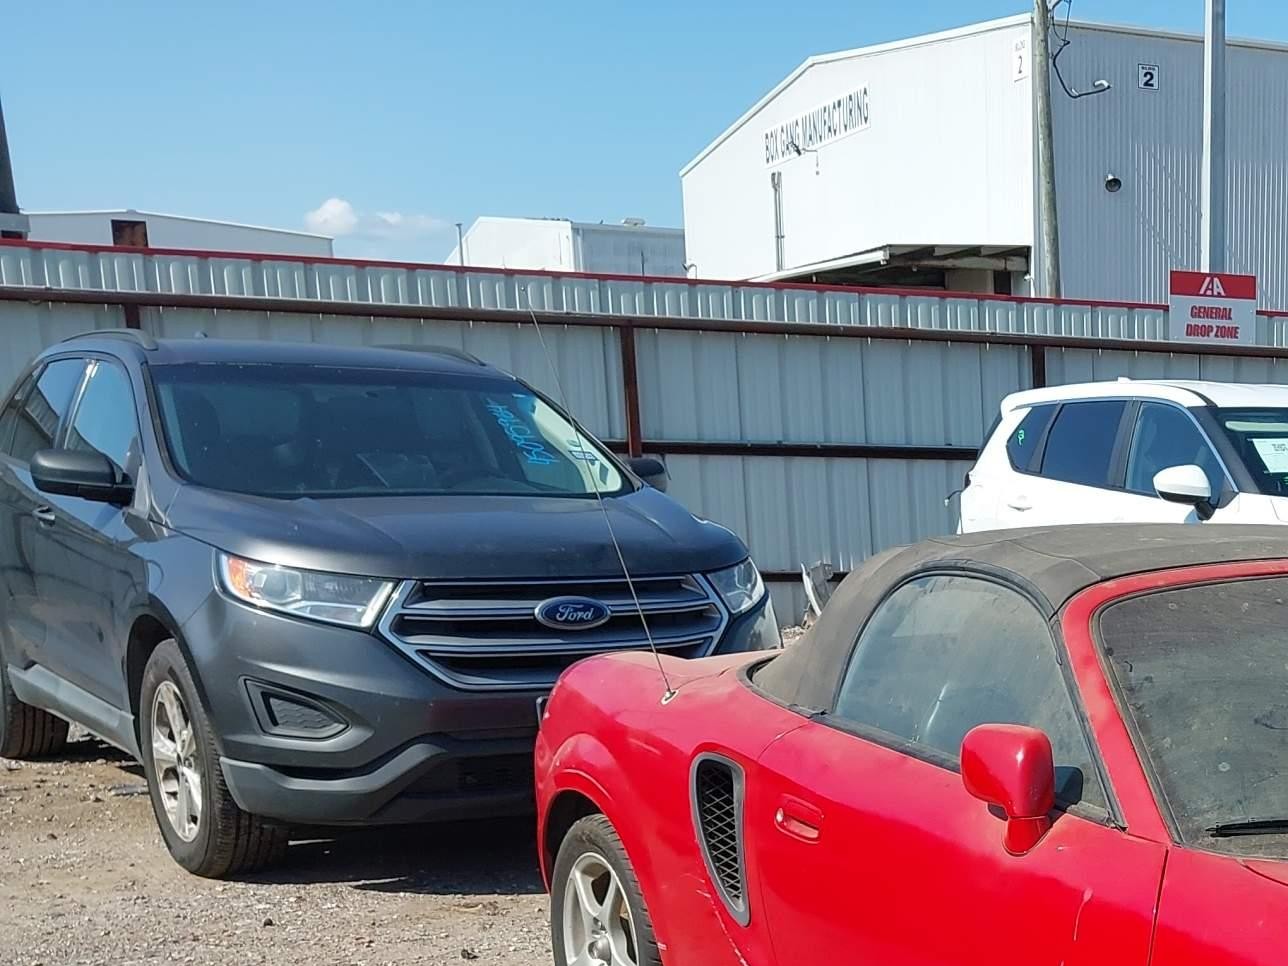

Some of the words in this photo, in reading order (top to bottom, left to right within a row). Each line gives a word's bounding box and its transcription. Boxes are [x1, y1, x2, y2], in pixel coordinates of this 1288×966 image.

[1143, 71, 1155, 88] 2
[765, 128, 779, 164] BOX
[780, 118, 800, 159] GANG
[801, 86, 869, 148] MANUFACTURING
[1190, 305, 1233, 321] GENERAL
[1185, 323, 1214, 339] DROP
[1215, 325, 1240, 340] ZONE
[556, 603, 595, 622] Ford
